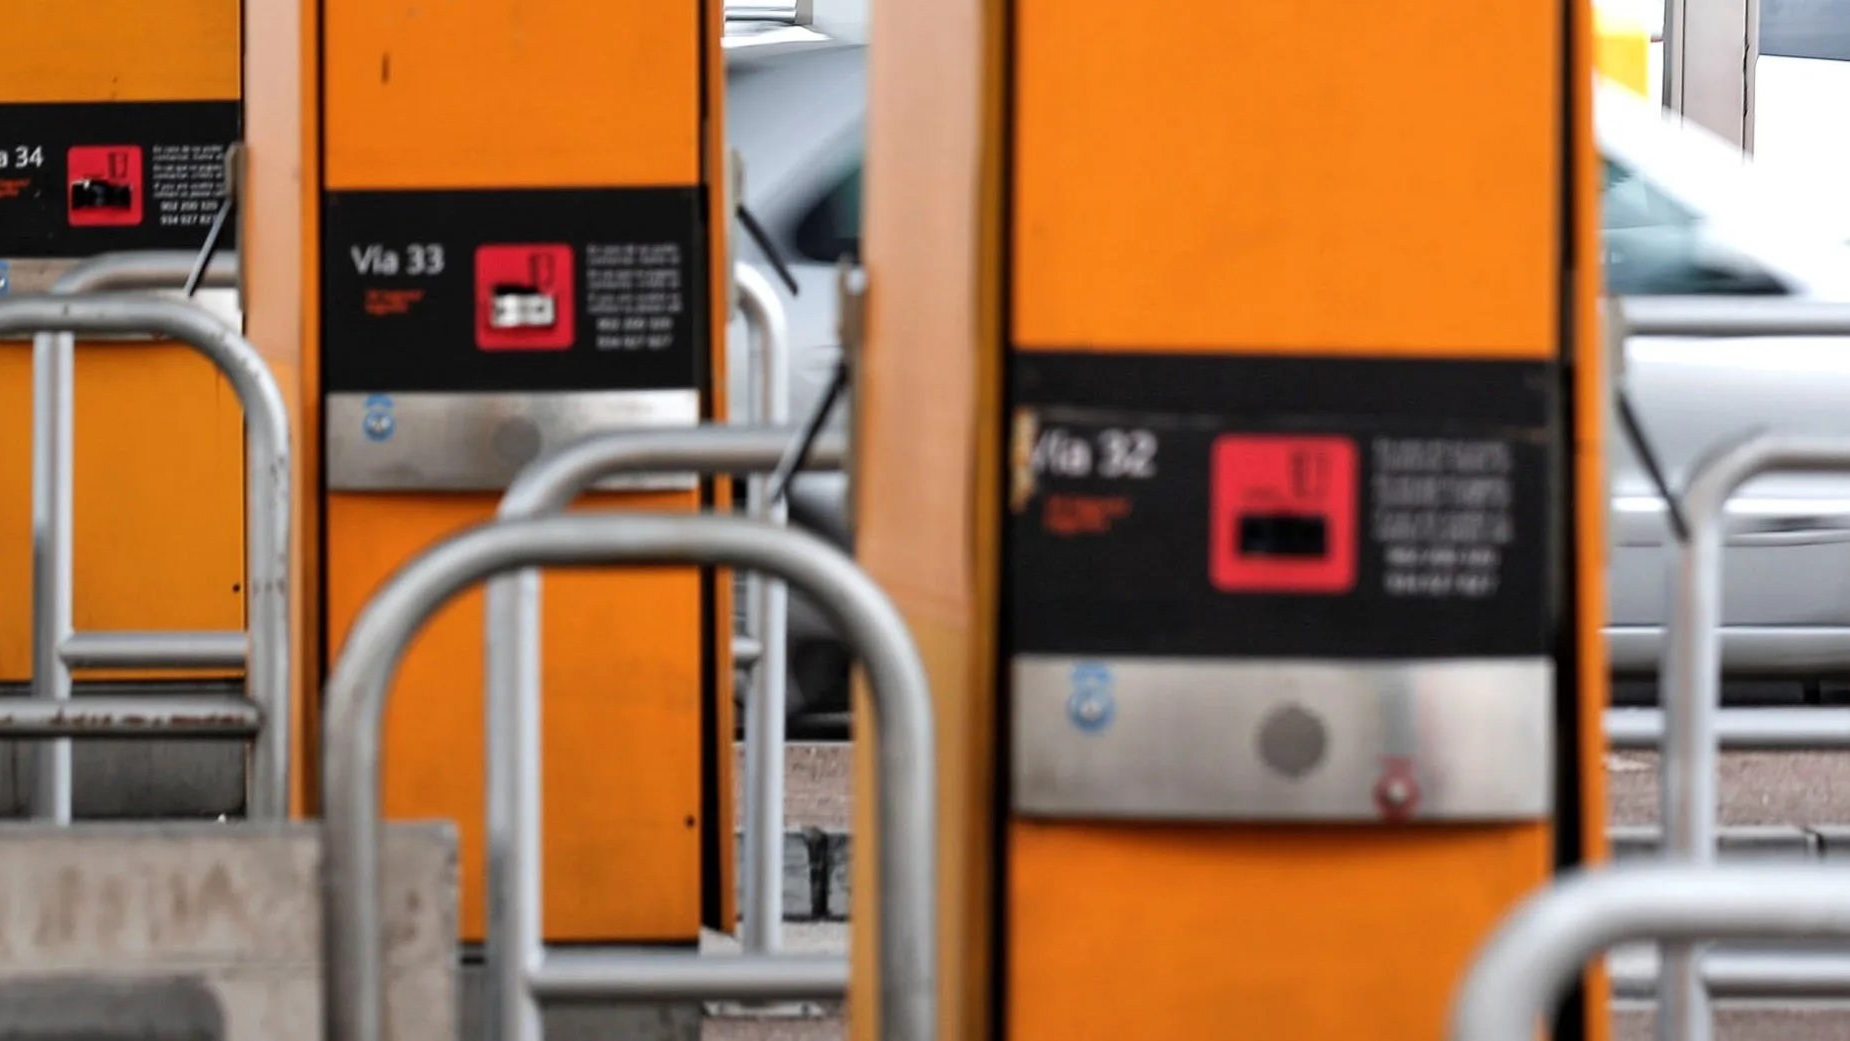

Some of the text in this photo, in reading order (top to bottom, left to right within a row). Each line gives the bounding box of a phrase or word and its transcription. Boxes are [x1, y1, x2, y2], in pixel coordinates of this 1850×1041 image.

[15, 145, 44, 168] 34
[407, 244, 445, 275] 33
[1100, 428, 1158, 478] 32
